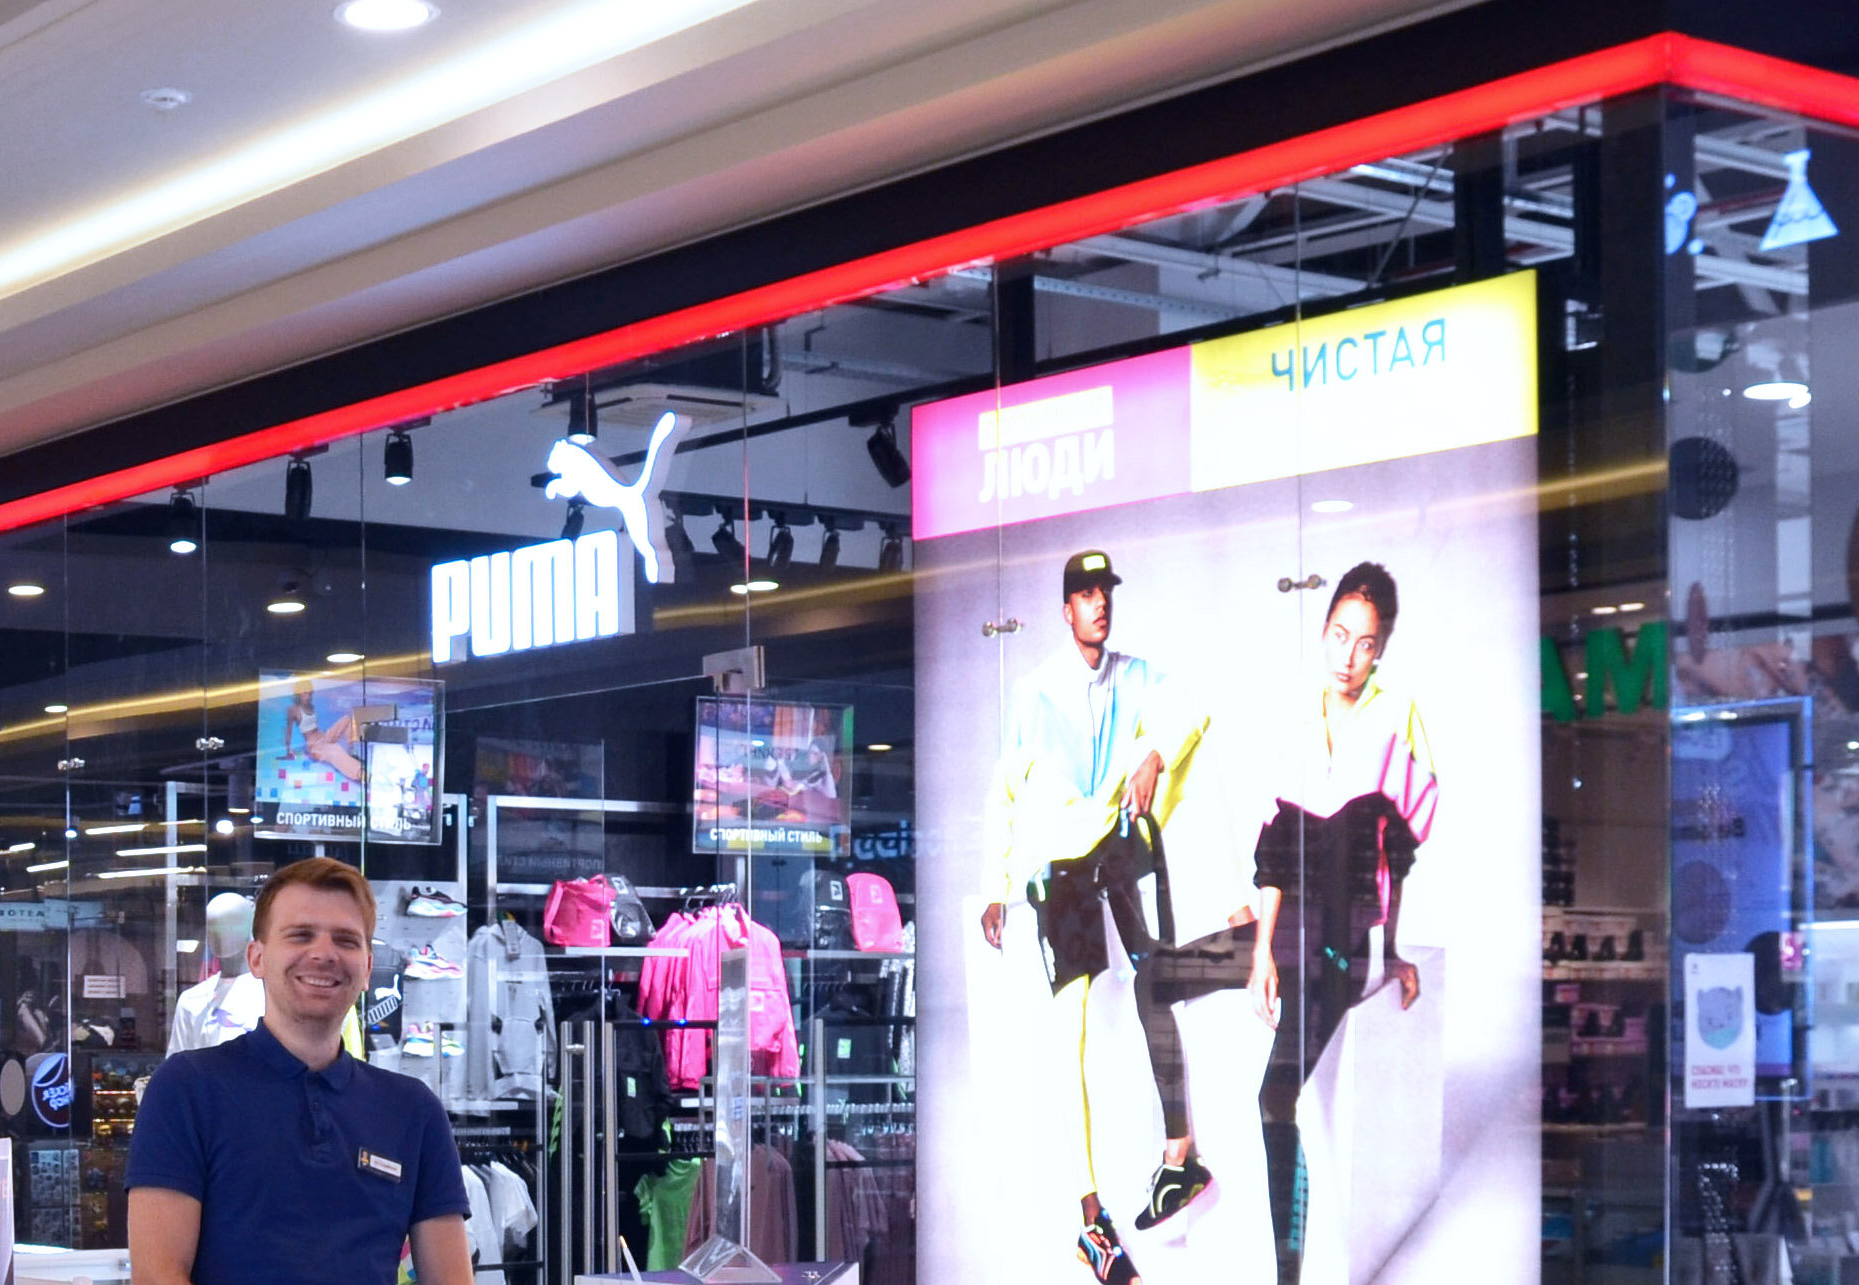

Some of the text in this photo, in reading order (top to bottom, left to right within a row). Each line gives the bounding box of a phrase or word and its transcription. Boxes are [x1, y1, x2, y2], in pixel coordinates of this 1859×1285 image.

[1270, 317, 1446, 392] ЧИСТАЯ
[978, 428, 1115, 504] ЛЮДИ
[431, 530, 619, 663] PUMA
[277, 812, 366, 828] СПОРТИВНЫЙ
[787, 830, 823, 844] СТИЛЬ
